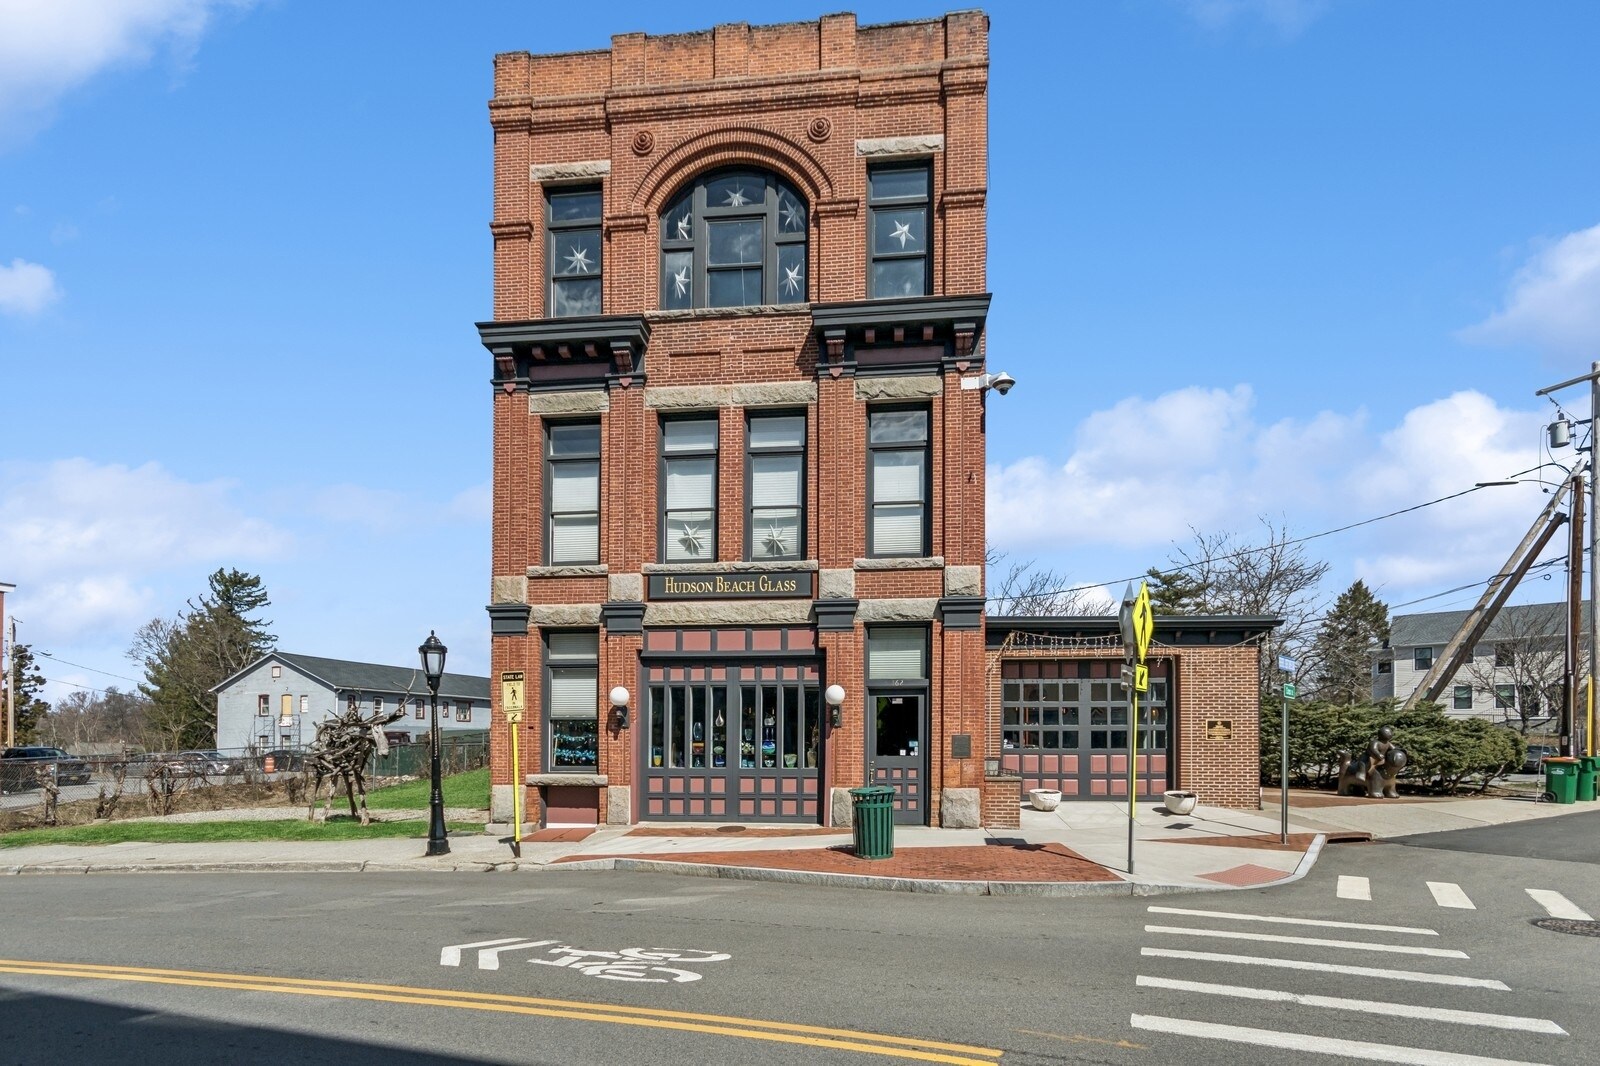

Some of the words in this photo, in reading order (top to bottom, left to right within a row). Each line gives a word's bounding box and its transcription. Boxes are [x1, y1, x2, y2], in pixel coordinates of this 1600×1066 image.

[665, 577, 713, 594] HUDSON
[716, 576, 755, 593] BEACH
[759, 575, 796, 592] GLASS
